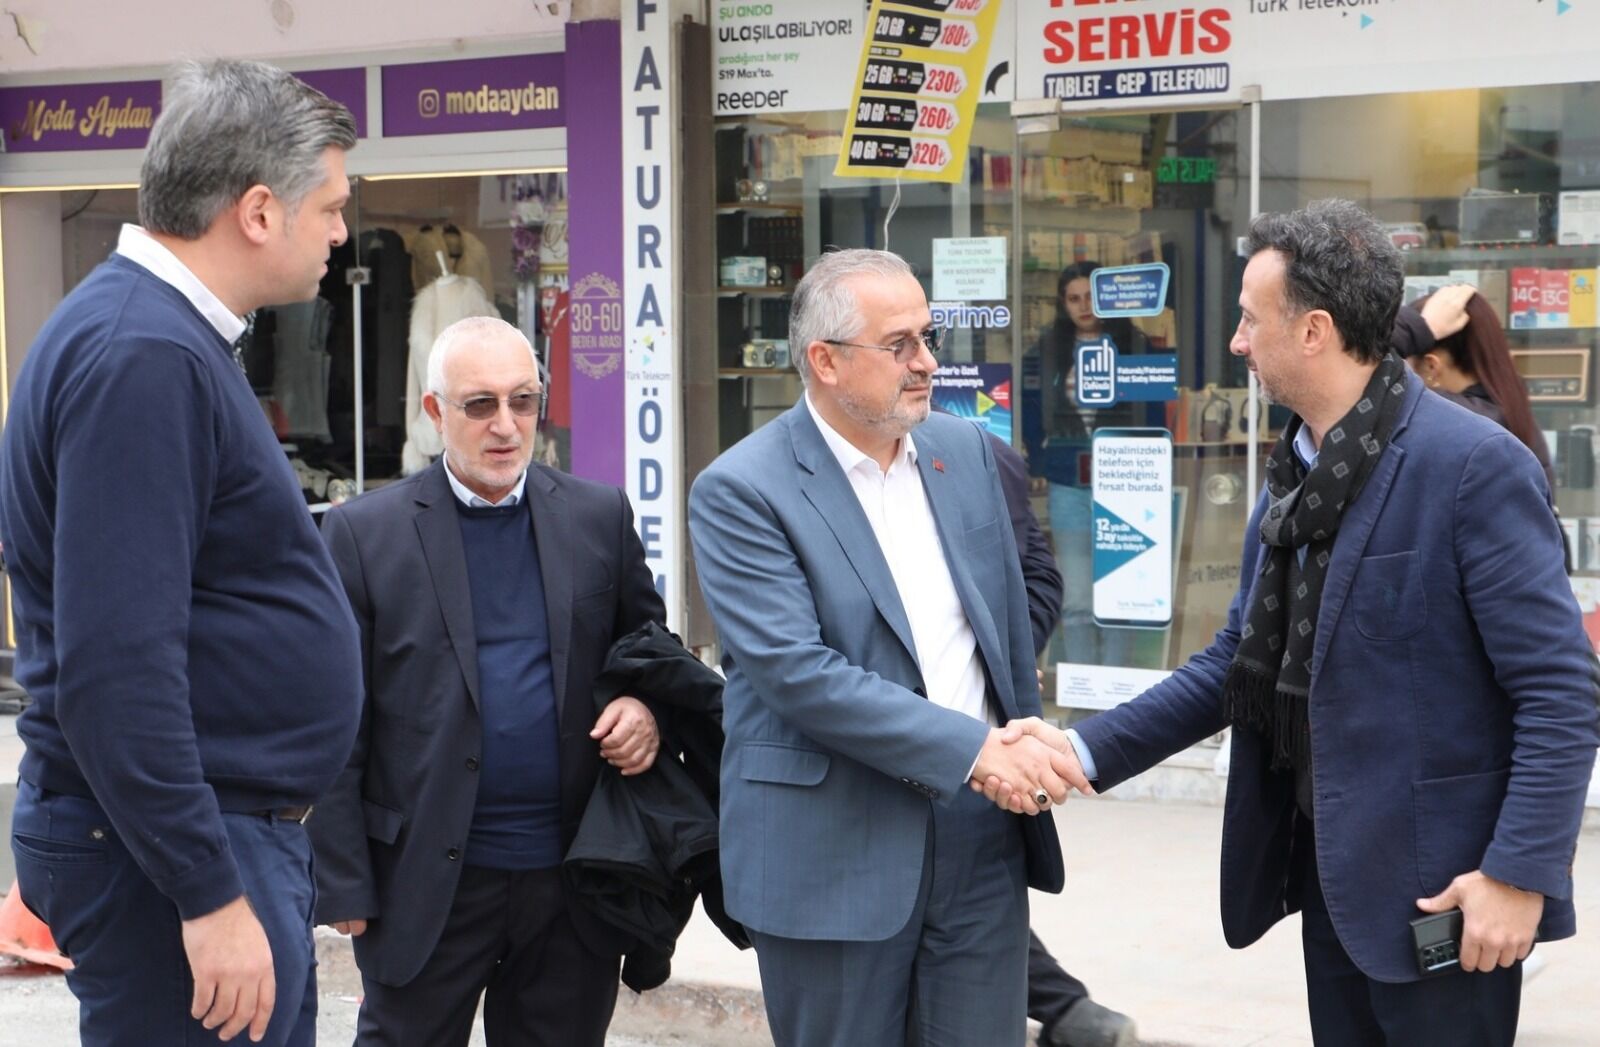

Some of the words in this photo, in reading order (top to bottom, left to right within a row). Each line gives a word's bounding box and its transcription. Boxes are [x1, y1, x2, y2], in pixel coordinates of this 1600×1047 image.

[875, 16, 889, 35] 20
[889, 17, 905, 37] GB
[766, 51, 783, 61] her
[719, 69, 735, 80] S19
[864, 64, 879, 83] 25
[878, 65, 894, 84] GB
[1046, 75, 1101, 98] TABLET
[1116, 72, 1146, 94] CEP
[1151, 66, 1227, 92] TELEFONU
[446, 82, 559, 116] modaaydan
[11, 99, 76, 141] Moda
[79, 95, 153, 138] Aydan
[857, 102, 872, 122] 30
[871, 103, 886, 122] GB
[850, 140, 864, 159] 40
[863, 141, 879, 160] GB
[1512, 287, 1540, 303] 14C
[1541, 289, 1569, 306] 13C
[571, 303, 621, 332] 38-60
[930, 303, 1010, 328] prime
[572, 336, 598, 349] BEDEN
[598, 335, 622, 348] ARASI
[627, 371, 641, 380] Türk
[1098, 445, 1167, 456] Hayalinizdeki
[1098, 457, 1134, 467] telefon
[1136, 458, 1154, 469] için
[1098, 469, 1159, 481] beklediğiniz
[1098, 482, 1125, 492] fırsat
[1127, 482, 1164, 492] burada
[1095, 518, 1110, 531] 12
